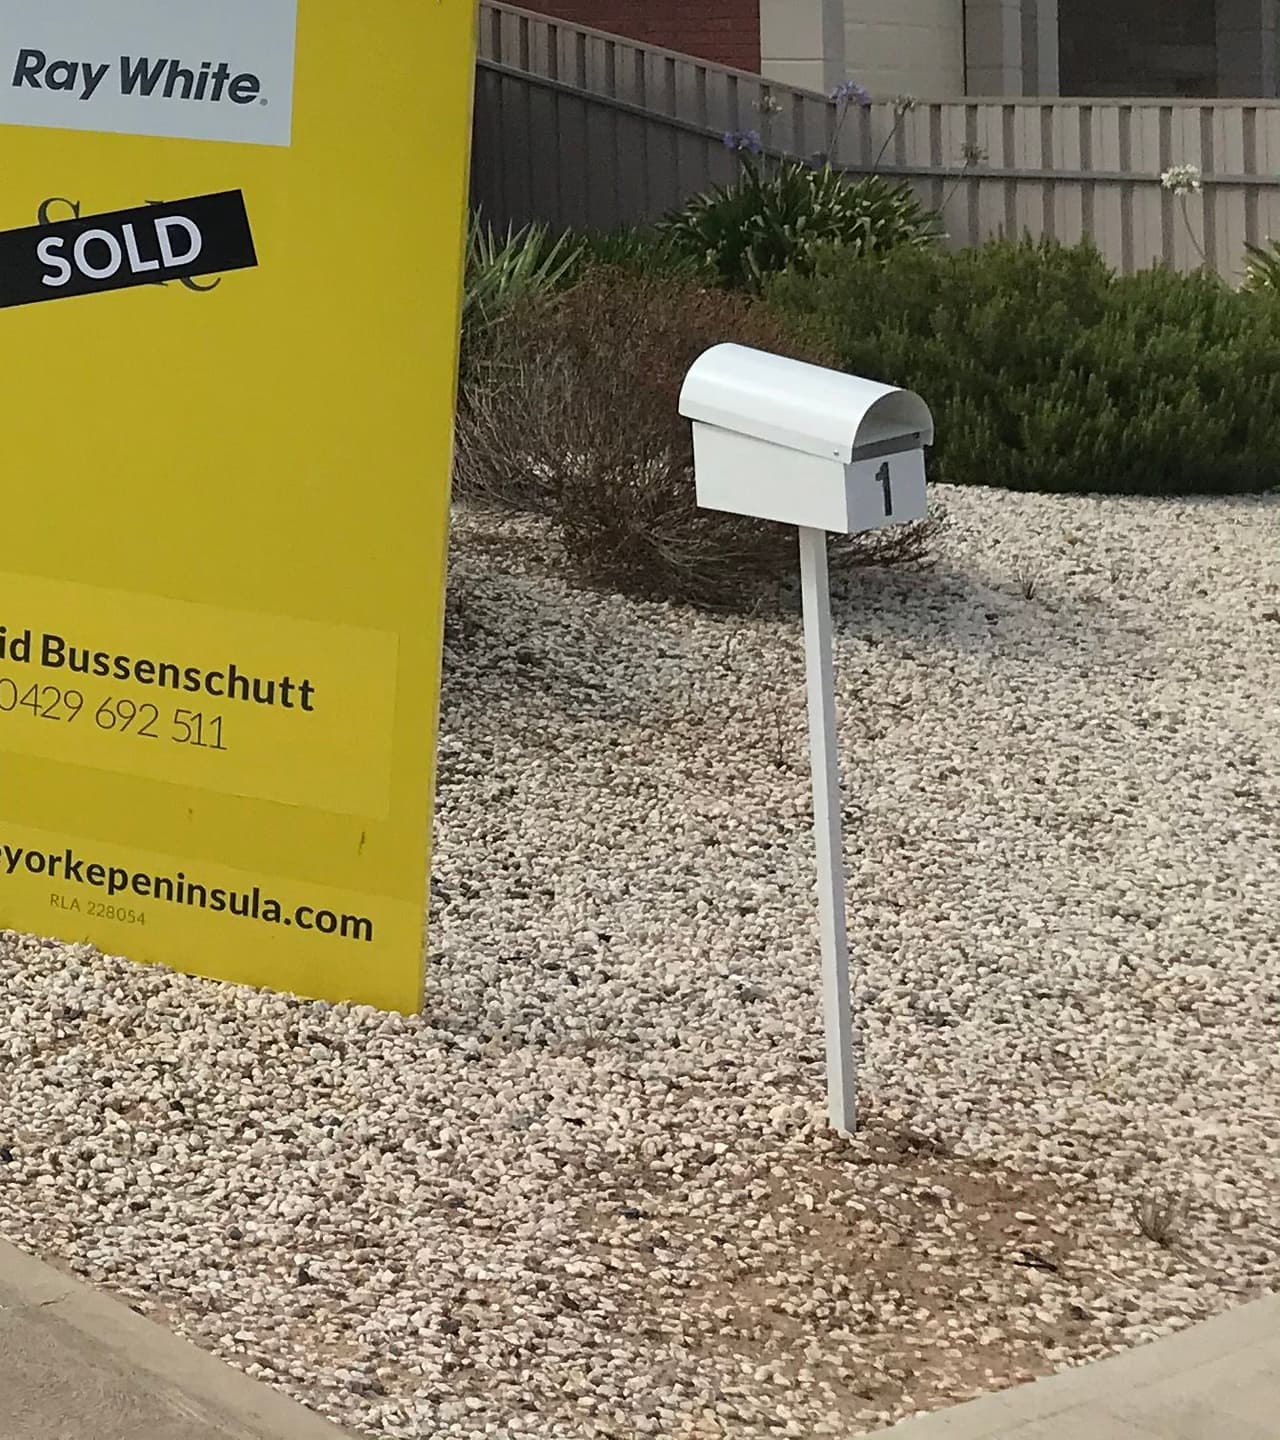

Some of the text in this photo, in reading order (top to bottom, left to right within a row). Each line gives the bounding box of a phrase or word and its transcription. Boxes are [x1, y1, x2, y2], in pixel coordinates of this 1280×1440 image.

[11, 48, 111, 101] Ray
[36, 215, 203, 287] SOLD
[875, 461, 892, 517] 1
[41, 633, 315, 712] Bussenschutt
[95, 696, 160, 739] 692
[171, 708, 228, 751] 511
[50, 893, 146, 926] RLA 228054
